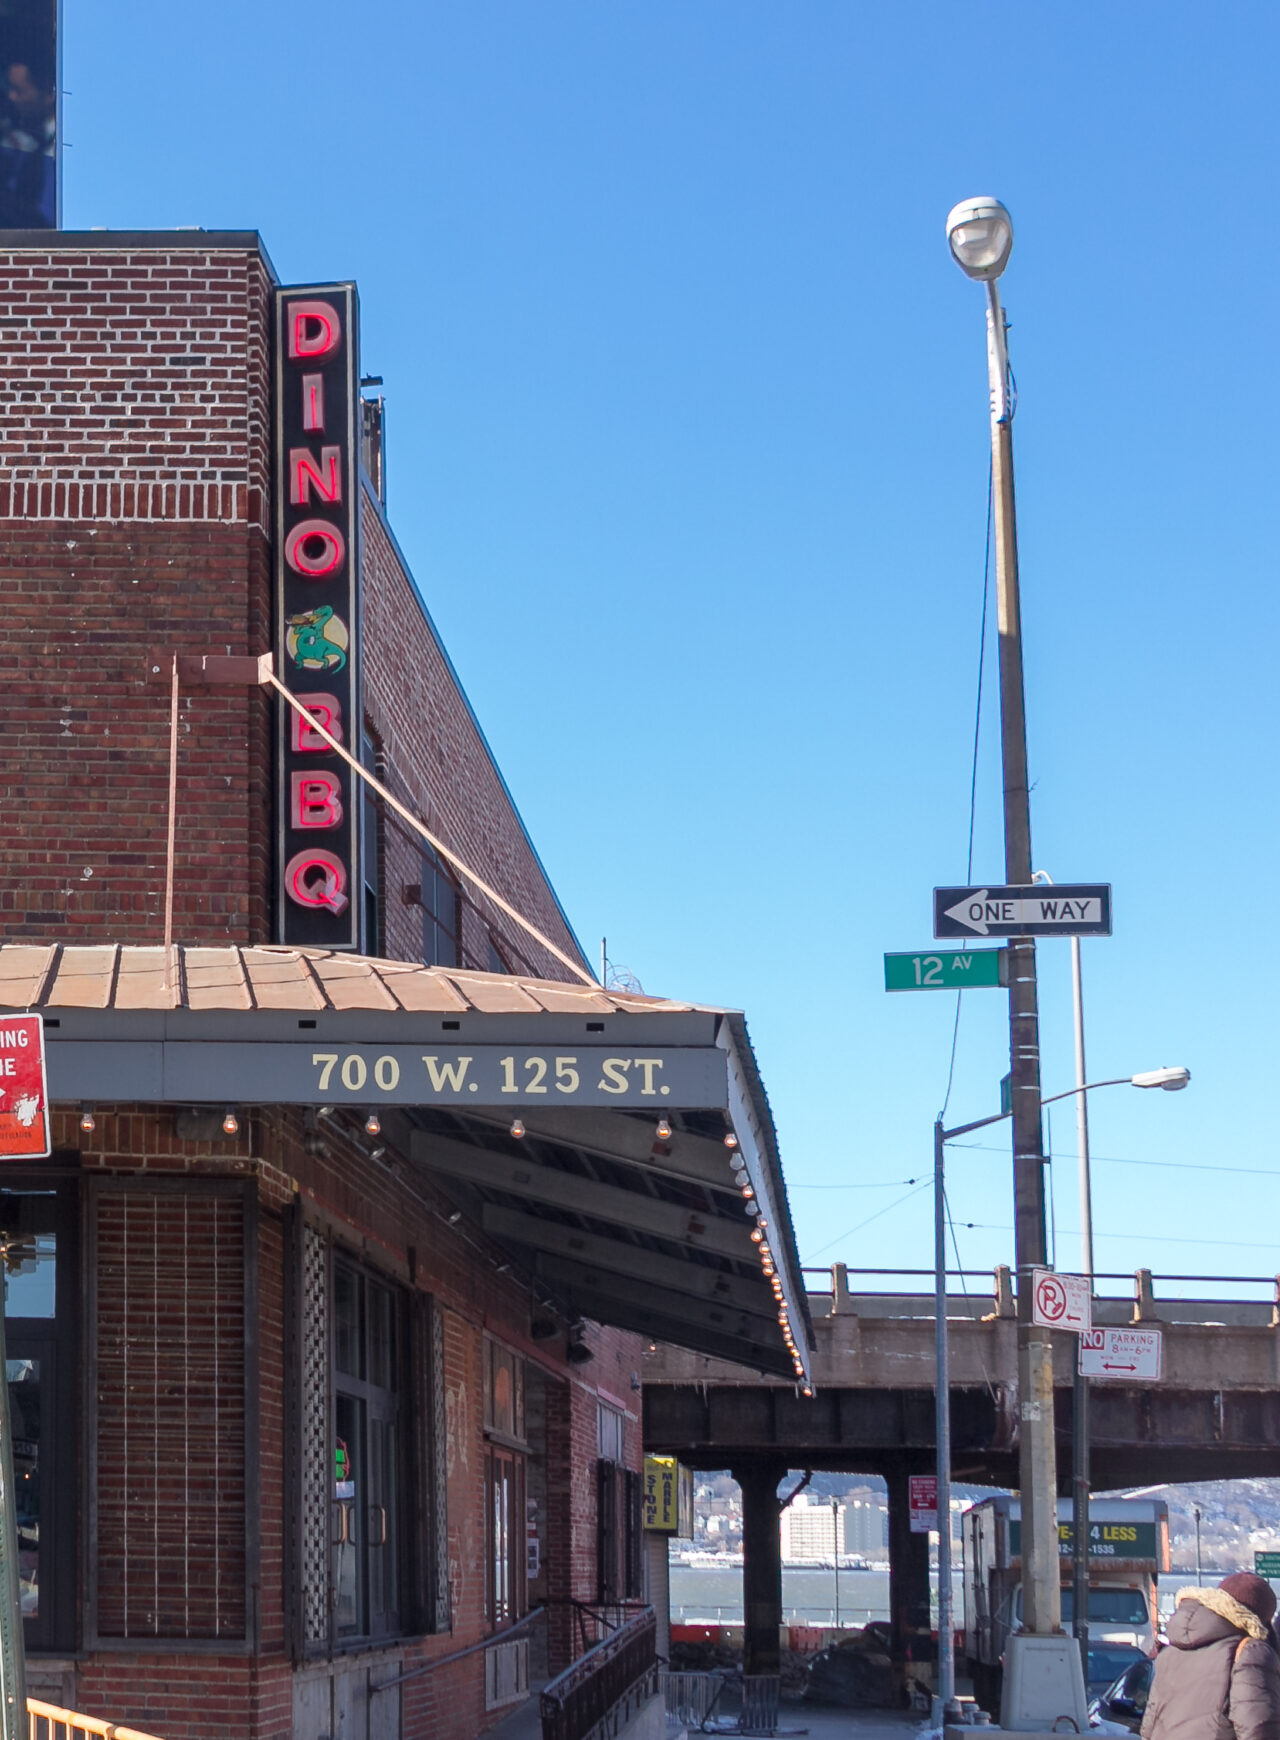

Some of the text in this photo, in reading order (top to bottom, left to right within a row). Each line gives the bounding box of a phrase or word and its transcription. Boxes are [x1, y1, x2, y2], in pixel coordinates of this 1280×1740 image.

[285, 300, 347, 916] DINO BBQ
[968, 900, 1091, 921] ONE WAY
[913, 955, 973, 986] 12 AV
[312, 1053, 671, 1096] 700 W. 125 ST.
[1083, 1331, 1154, 1348] NO PARKING
[647, 1474, 657, 1524] STONE
[1090, 1526, 1100, 1539] 4
[1103, 1526, 1137, 1541] LESS
